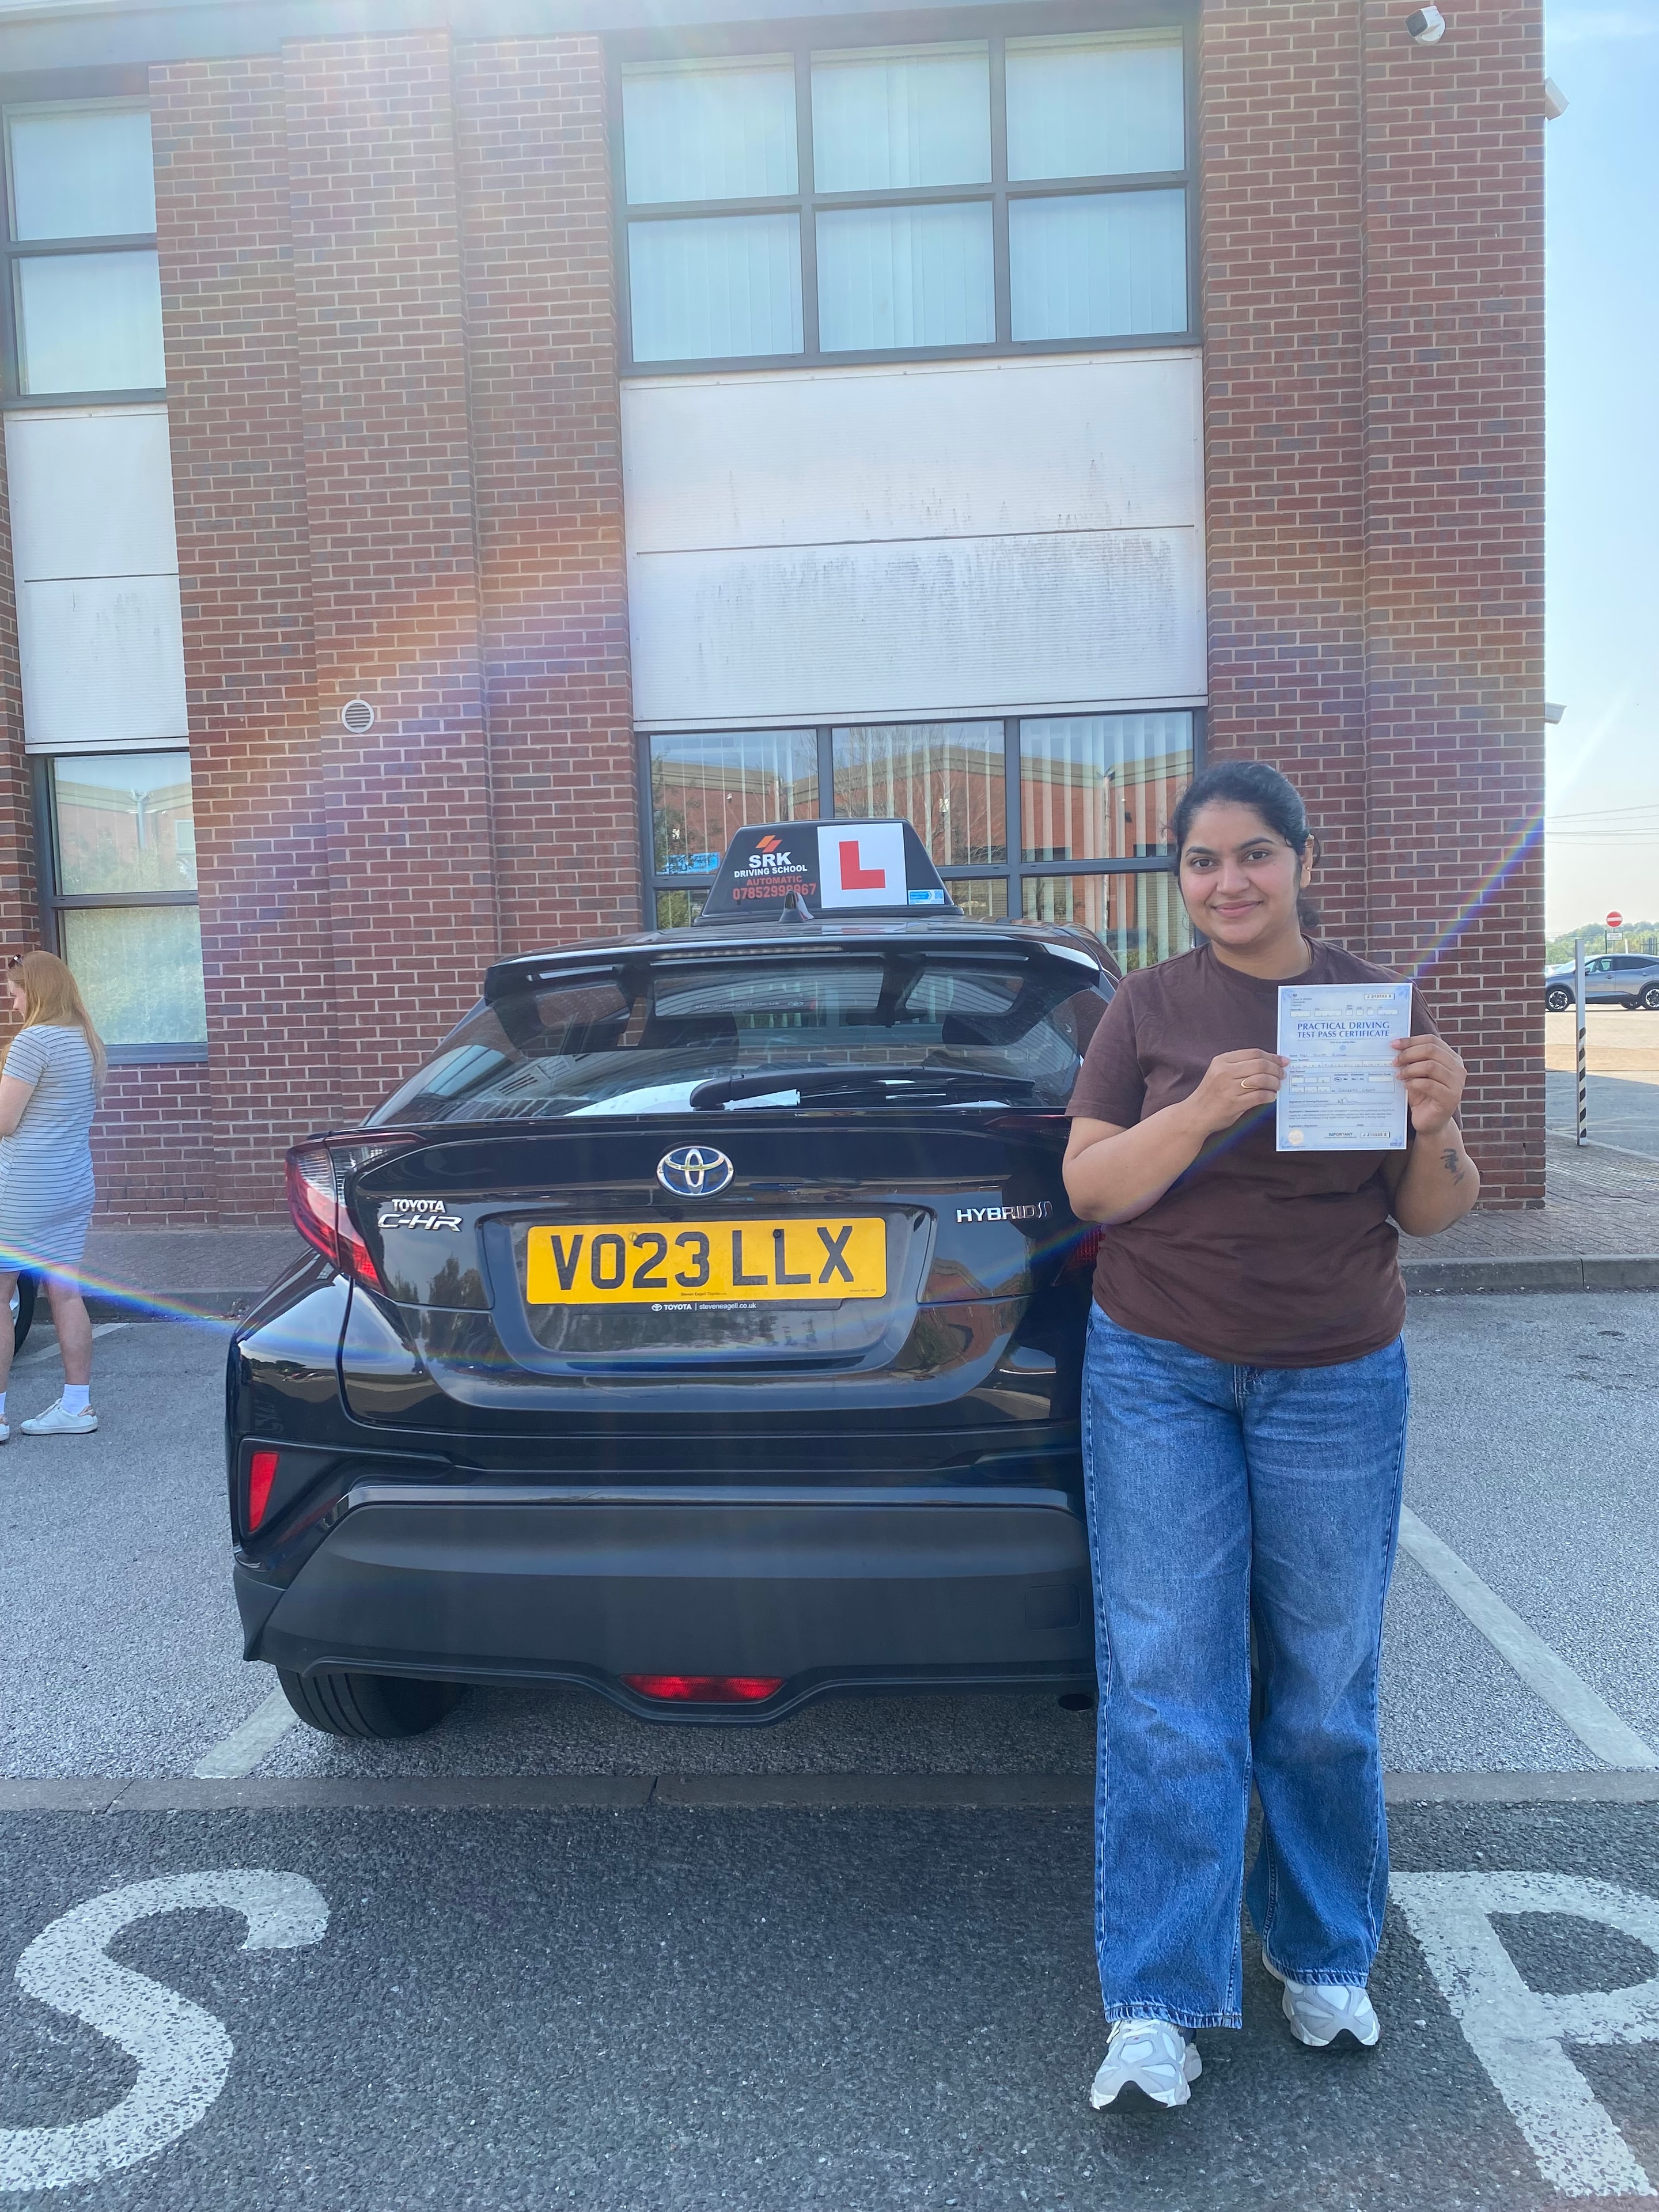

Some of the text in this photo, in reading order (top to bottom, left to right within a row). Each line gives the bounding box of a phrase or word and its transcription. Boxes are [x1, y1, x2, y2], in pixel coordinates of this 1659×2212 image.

[749, 852, 791, 868] SRK
[839, 840, 886, 891] L
[734, 865, 808, 878] DRIVING SCHOOL
[746, 875, 802, 887] AUTOMATIC
[392, 1199, 446, 1213] TOYOTA
[956, 1205, 1037, 1222] HYBRID
[377, 1213, 463, 1232] C-HR
[551, 1225, 854, 1290] VO23 LLX
[699, 1302, 757, 1310] steveneagell.co.uk
[0, 1868, 329, 2191] S
